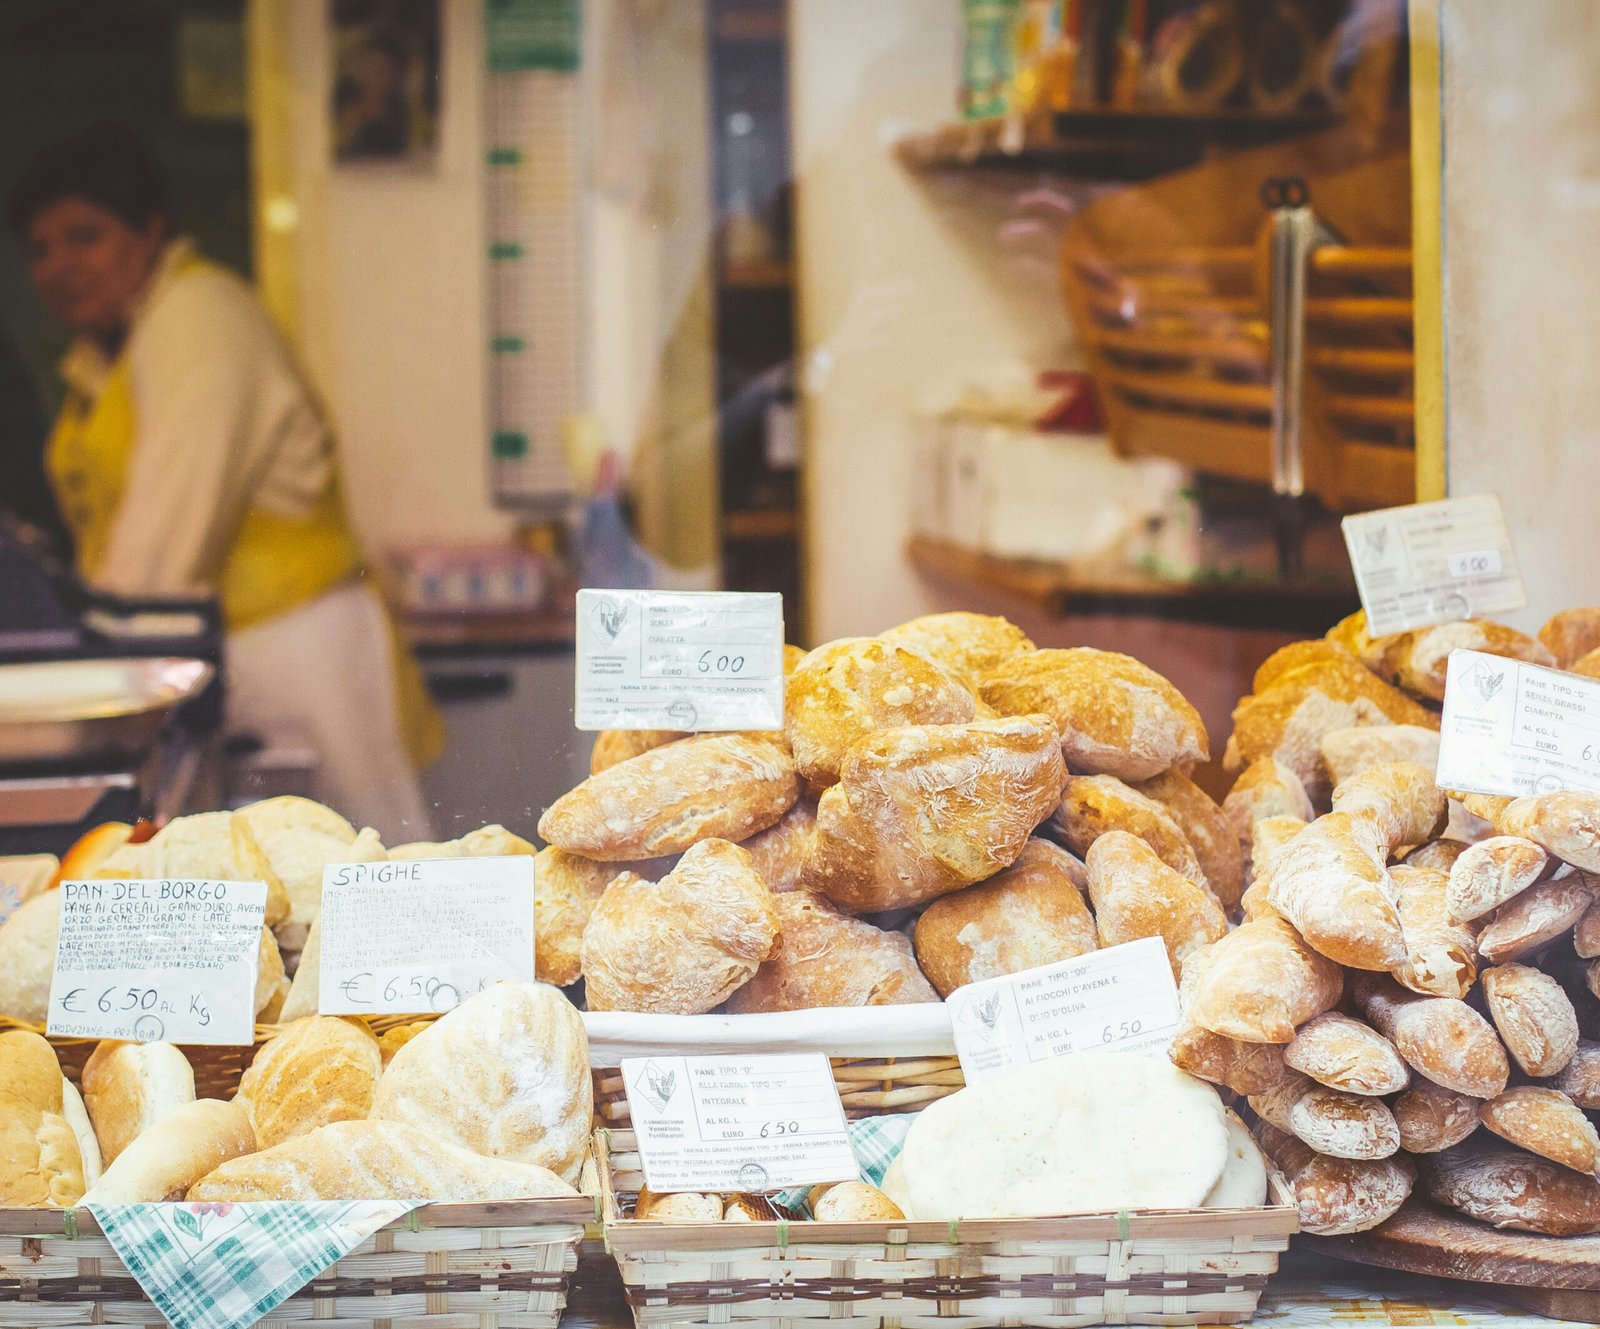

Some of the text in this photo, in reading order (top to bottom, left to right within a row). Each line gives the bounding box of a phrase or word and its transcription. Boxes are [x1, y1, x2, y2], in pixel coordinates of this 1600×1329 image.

[1525, 677, 1547, 689] PANE
[1552, 683, 1571, 696] TIPO
[1525, 690, 1586, 713] SENZA GRASSI
[1524, 705, 1564, 721] CIABATTA
[1521, 723, 1533, 733] AL
[1535, 740, 1558, 751] EURO
[332, 863, 421, 886] SPIGHE
[64, 902, 92, 915] PANE
[64, 915, 92, 925] ORZO
[153, 912, 187, 923] GRANO
[1020, 979, 1043, 991] PANE
[1048, 971, 1069, 982] TIPO
[1025, 975, 1118, 1006] AI FIOCCHI D'AVENA E
[58, 988, 87, 1013] €
[97, 985, 158, 1013] 6.50
[160, 1000, 177, 1014] AL
[1051, 1001, 1086, 1017] D'OLIVA
[1034, 1034, 1045, 1042] AL
[1103, 1019, 1142, 1043] 6.50
[694, 1068, 716, 1077] PANE
[719, 1066, 738, 1075] TIPO
[698, 1081, 718, 1089] ALLA
[719, 1081, 749, 1089] FARINA
[750, 1080, 770, 1089] TIPO
[701, 1097, 747, 1106] INTEGRALE
[722, 1130, 744, 1138] EURO
